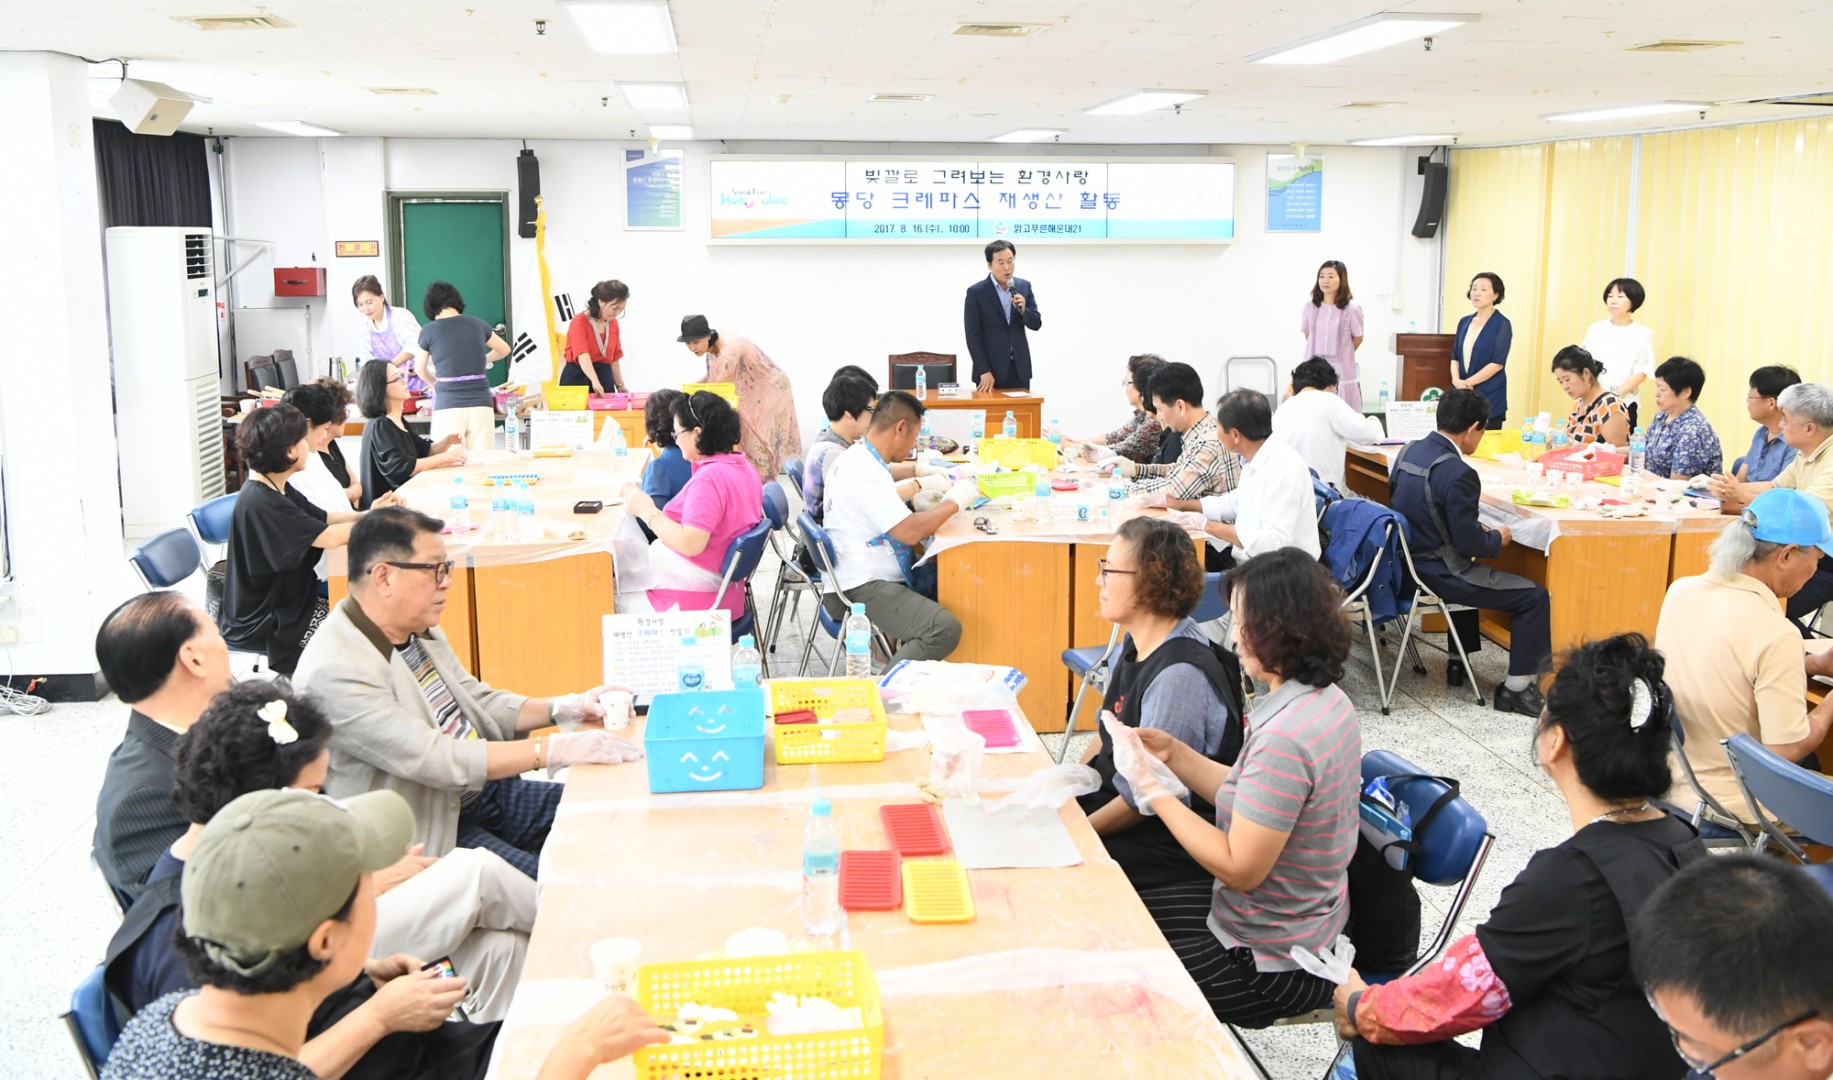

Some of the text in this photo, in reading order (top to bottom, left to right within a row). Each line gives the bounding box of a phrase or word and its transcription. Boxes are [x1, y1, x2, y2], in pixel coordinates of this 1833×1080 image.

[932, 168, 1005, 185] 그려보는
[1017, 168, 1090, 185] 환경사랑
[831, 191, 1121, 210] 몽당 크레파스 재생산 활동
[948, 223, 970, 234] 10:00
[1013, 223, 1082, 234] 맑고푸른해운대21
